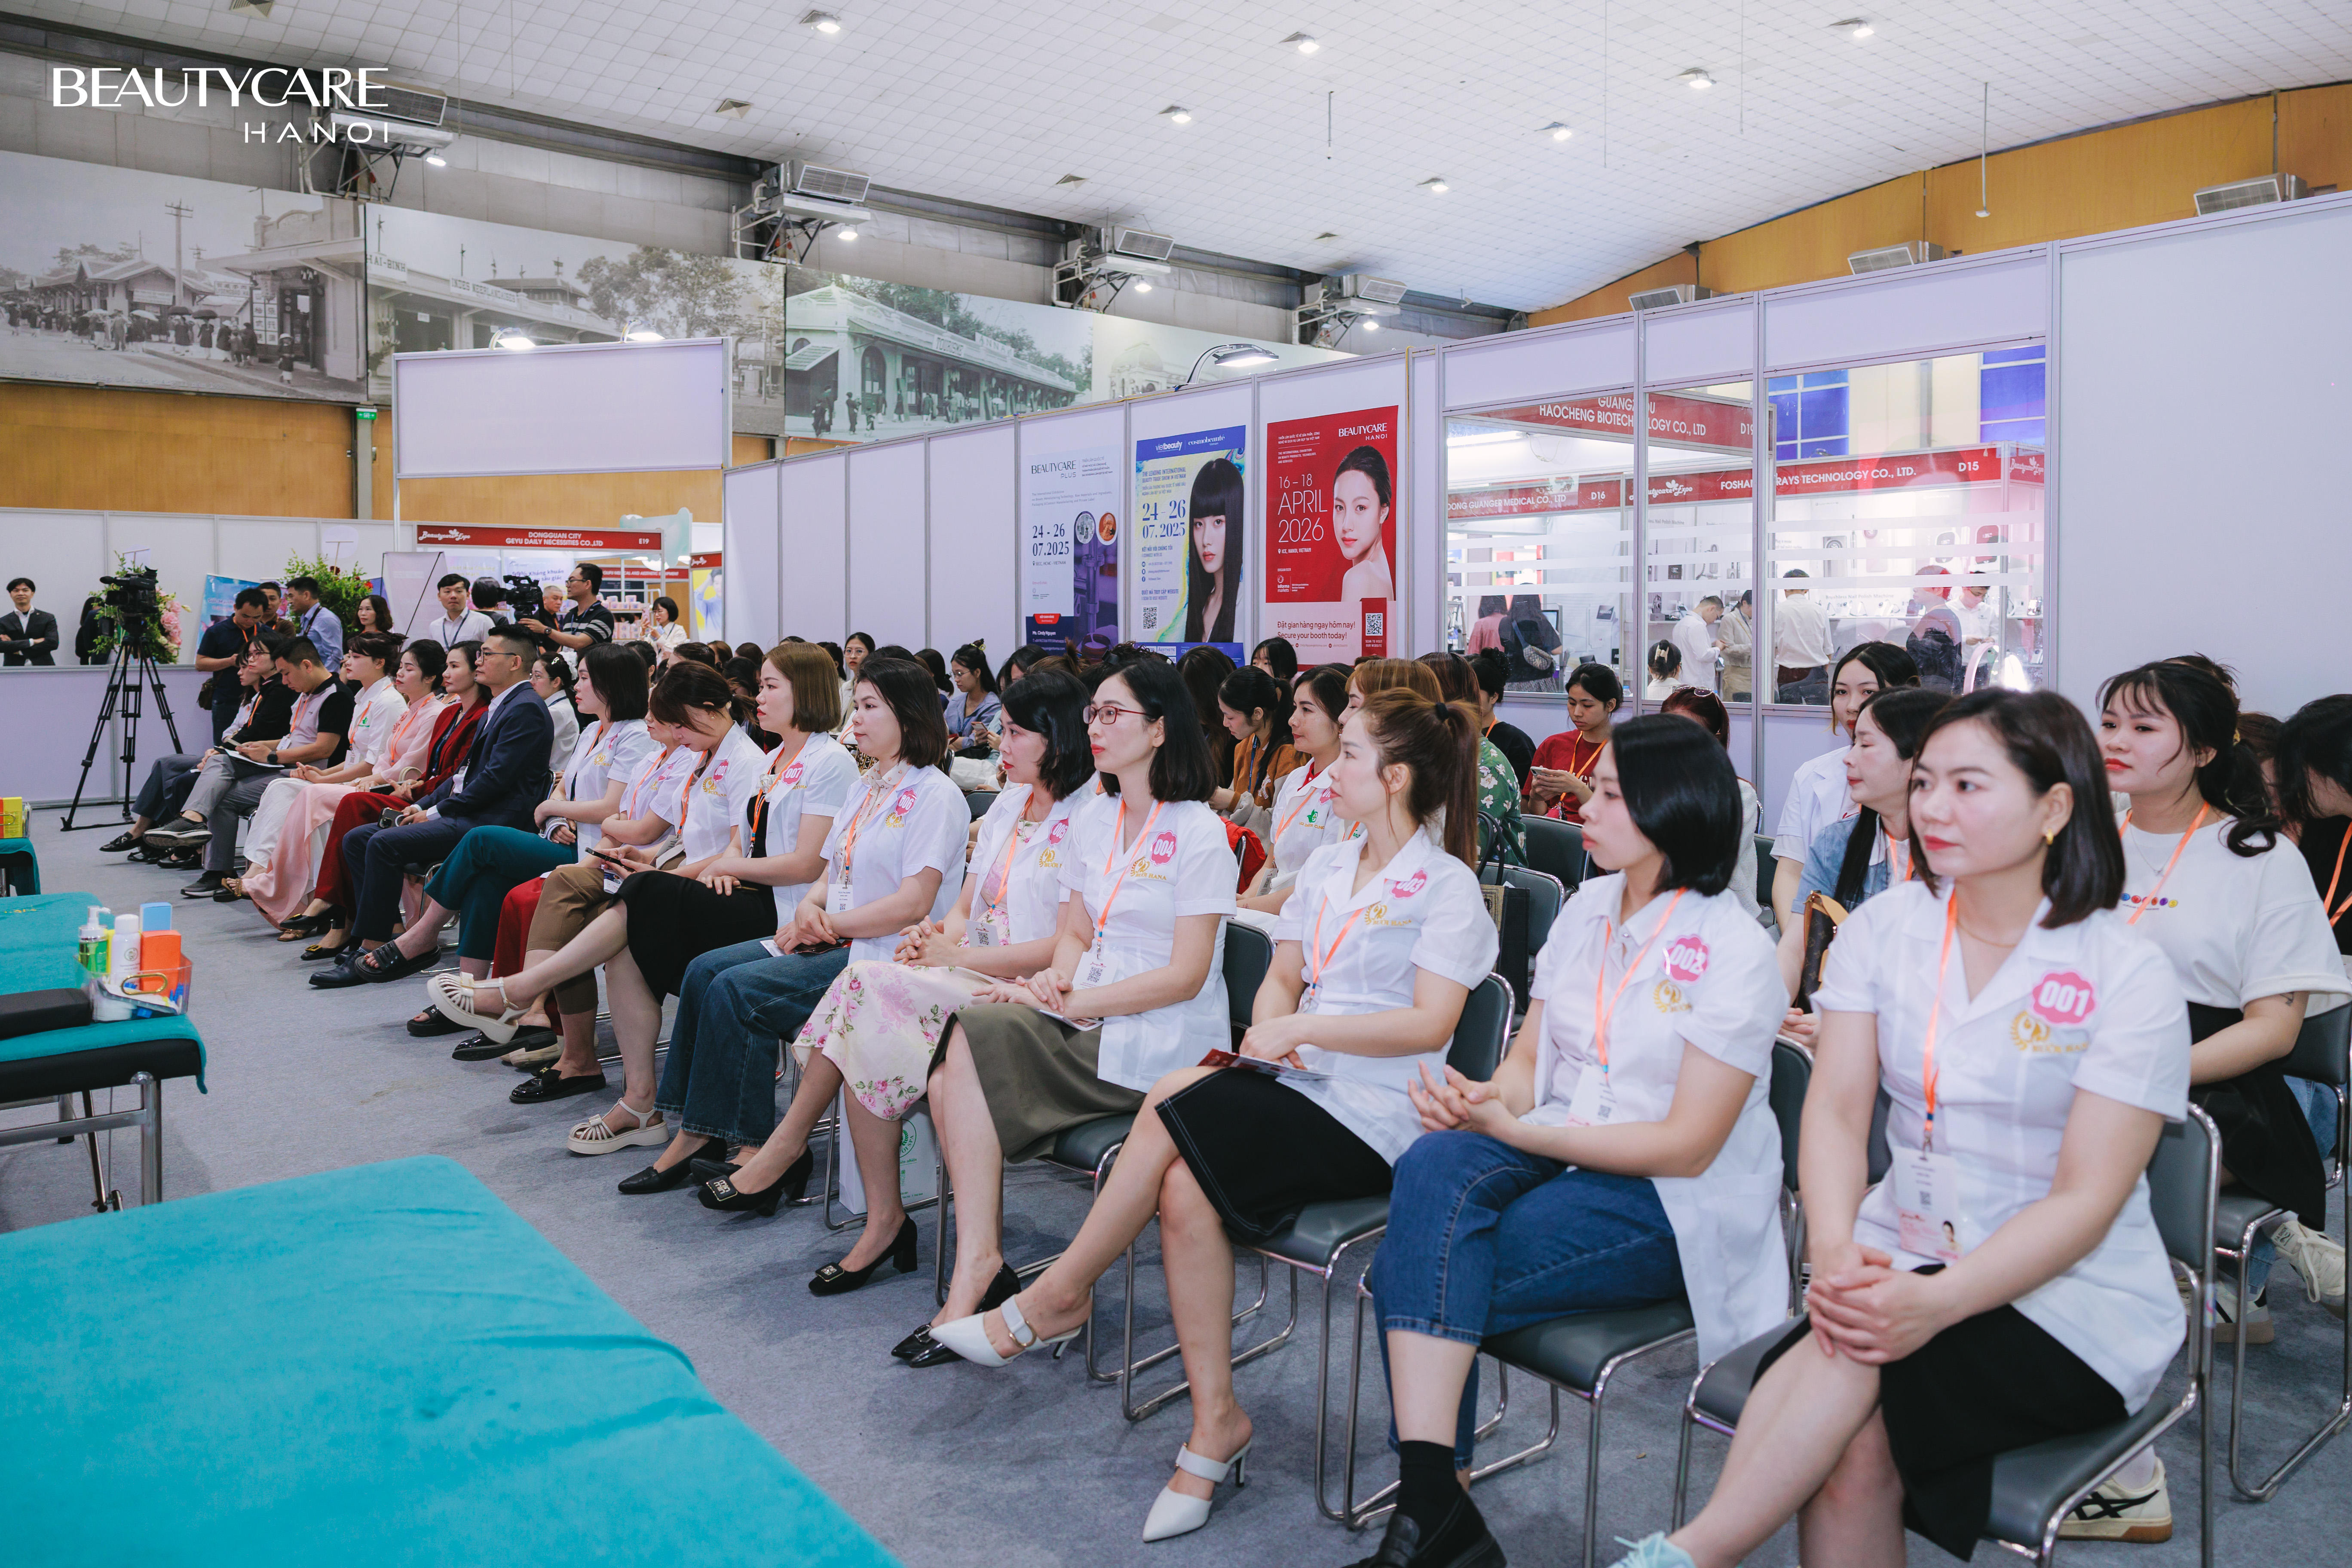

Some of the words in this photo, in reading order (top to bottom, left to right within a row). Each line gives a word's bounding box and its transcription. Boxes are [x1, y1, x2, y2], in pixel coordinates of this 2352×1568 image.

[1598, 397, 1655, 414] GUANGZOU
[1540, 405, 1595, 423] HAOCHENG
[1597, 409, 1671, 431] BIOTECHLOGY
[1673, 421, 1691, 436] CO.,
[1693, 422, 1706, 436] LTD
[1338, 423, 1387, 437] BEAUTYCARE
[1155, 441, 1182, 451] vietbeauty
[1188, 435, 1225, 446] cosmobeauté
[1032, 460, 1076, 474] BEAUTYCARE
[1959, 461, 1979, 472] D15
[1279, 476, 1290, 489] 16
[1302, 473, 1312, 487] 18
[1801, 470, 1869, 484] TECHNOLOGY
[1871, 469, 1894, 479] CO.,
[1897, 466, 1916, 477] LTD.
[1278, 489, 1328, 515] APRIL
[1469, 500, 1502, 510] GUANGER
[1504, 497, 1535, 508] MEDICAL
[1537, 496, 1553, 505] CO.,
[1554, 494, 1566, 503] LTD
[1591, 491, 1606, 500] D16
[1142, 502, 1158, 521] 24
[1169, 499, 1185, 518] 26
[1032, 525, 1043, 538] 24
[1054, 524, 1065, 537] 26
[1279, 517, 1324, 542] 2026
[1033, 541, 1069, 556] 07.2025
[1277, 621, 1287, 629] Đặt
[1300, 621, 1314, 629] hàng
[1343, 622, 1355, 630] nay!
[1328, 632, 1347, 640] today!
[785, 767, 802, 779] 007
[898, 794, 914, 811] 006
[1053, 822, 1068, 839] 005
[1153, 839, 1174, 857] 004
[1396, 878, 1425, 893] 003
[1669, 944, 1707, 975] 002
[2039, 980, 2091, 1017] 001
